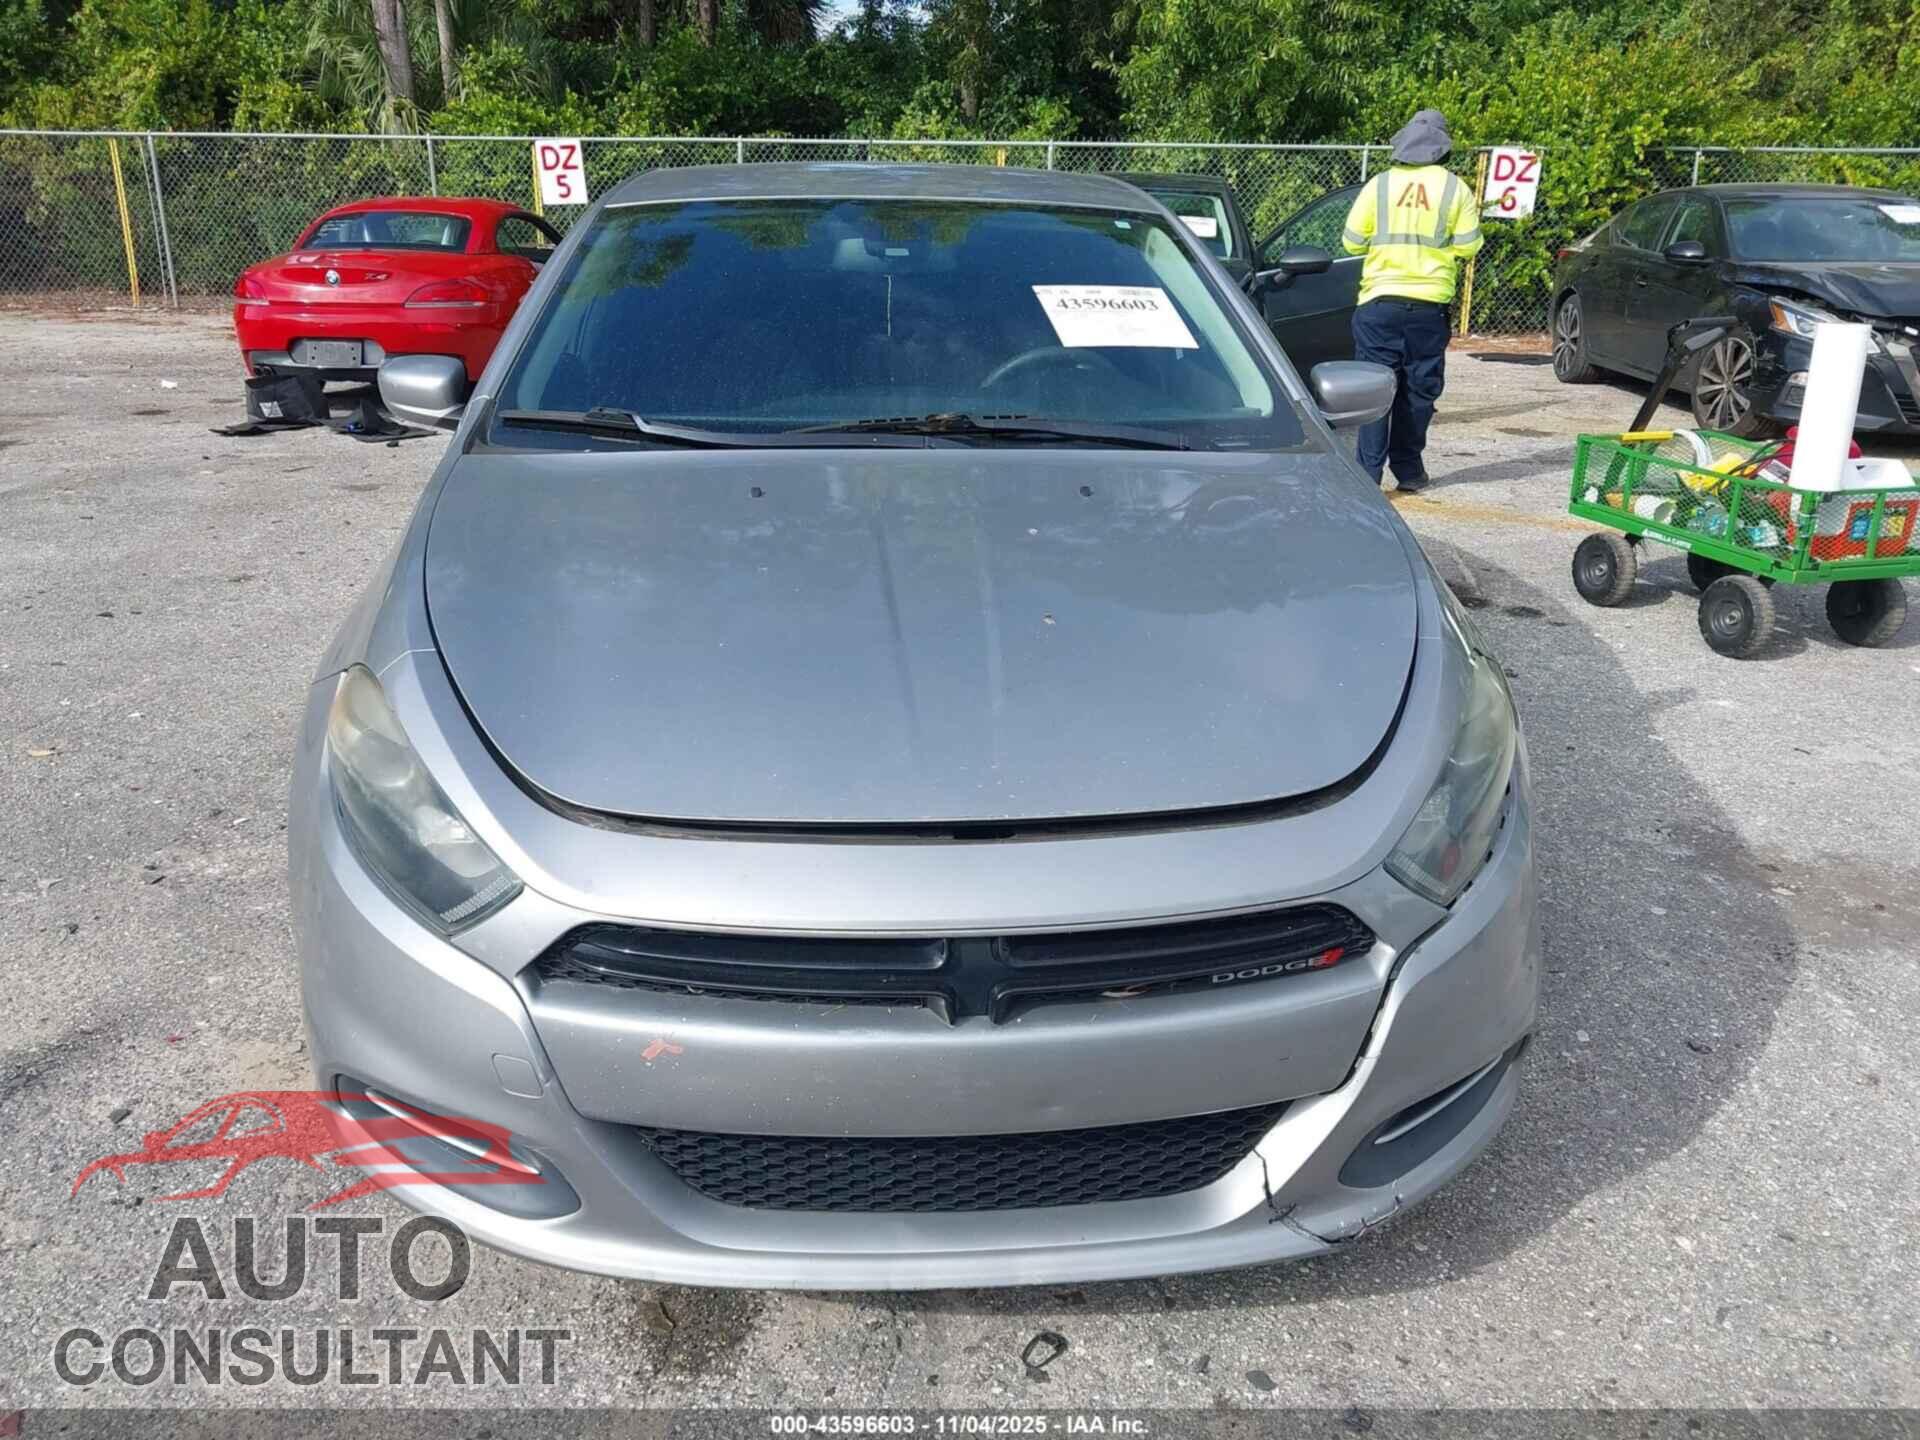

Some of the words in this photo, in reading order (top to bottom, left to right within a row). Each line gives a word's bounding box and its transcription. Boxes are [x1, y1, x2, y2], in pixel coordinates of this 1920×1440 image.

[541, 145, 578, 170] DZ
[1494, 155, 1537, 182] DZ
[556, 174, 571, 198] 5
[1501, 186, 1516, 211] 6
[1057, 298, 1159, 311] 43596603
[1212, 955, 1328, 984] DODGE
